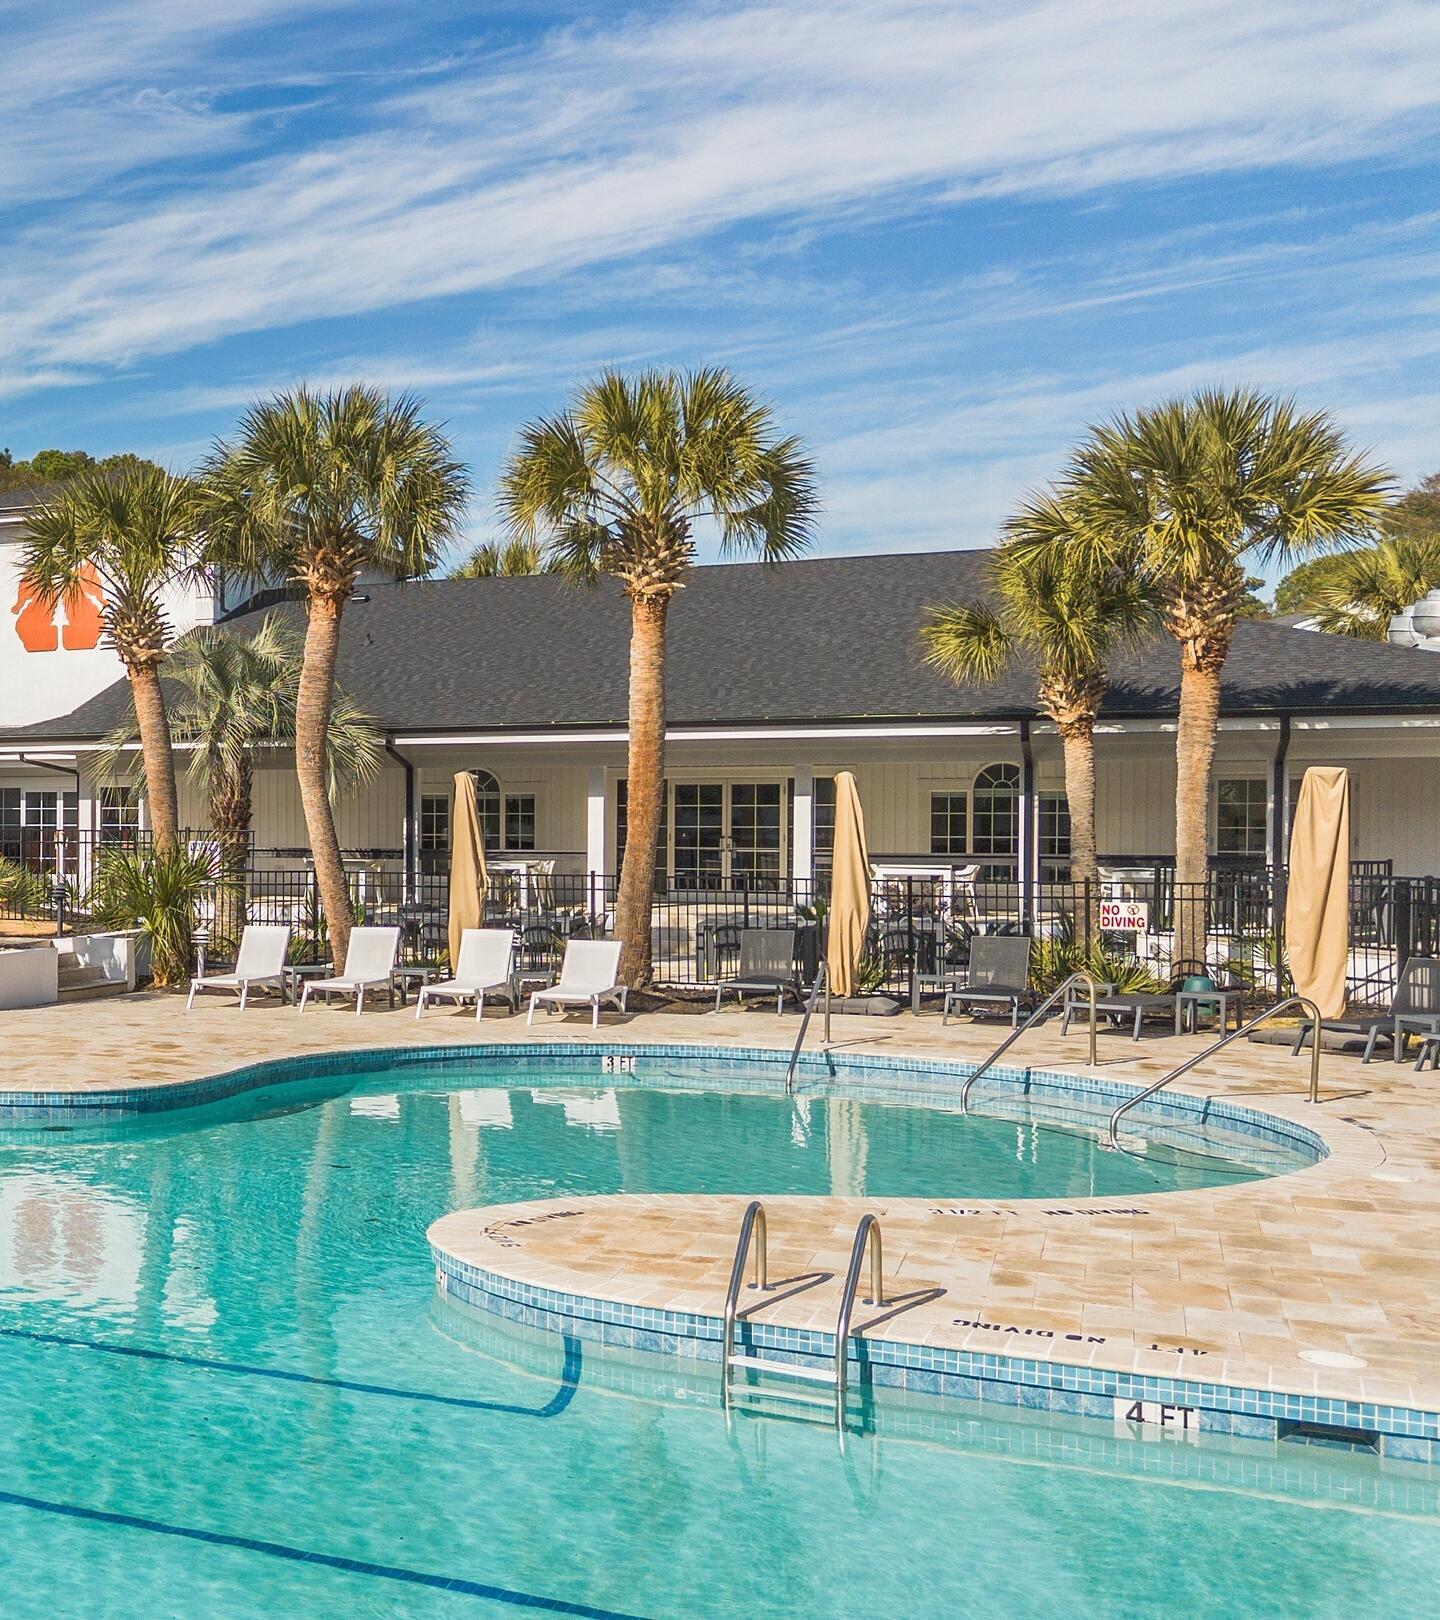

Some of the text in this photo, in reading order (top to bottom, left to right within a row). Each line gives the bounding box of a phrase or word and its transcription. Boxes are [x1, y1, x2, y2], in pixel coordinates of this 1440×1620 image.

[1102, 905, 1120, 915] NO
[1102, 916, 1145, 928] DIVING
[952, 1319, 1054, 1338] DIVING
[1065, 1334, 1106, 1345] NO
[1126, 1401, 1195, 1429] 4 FT
